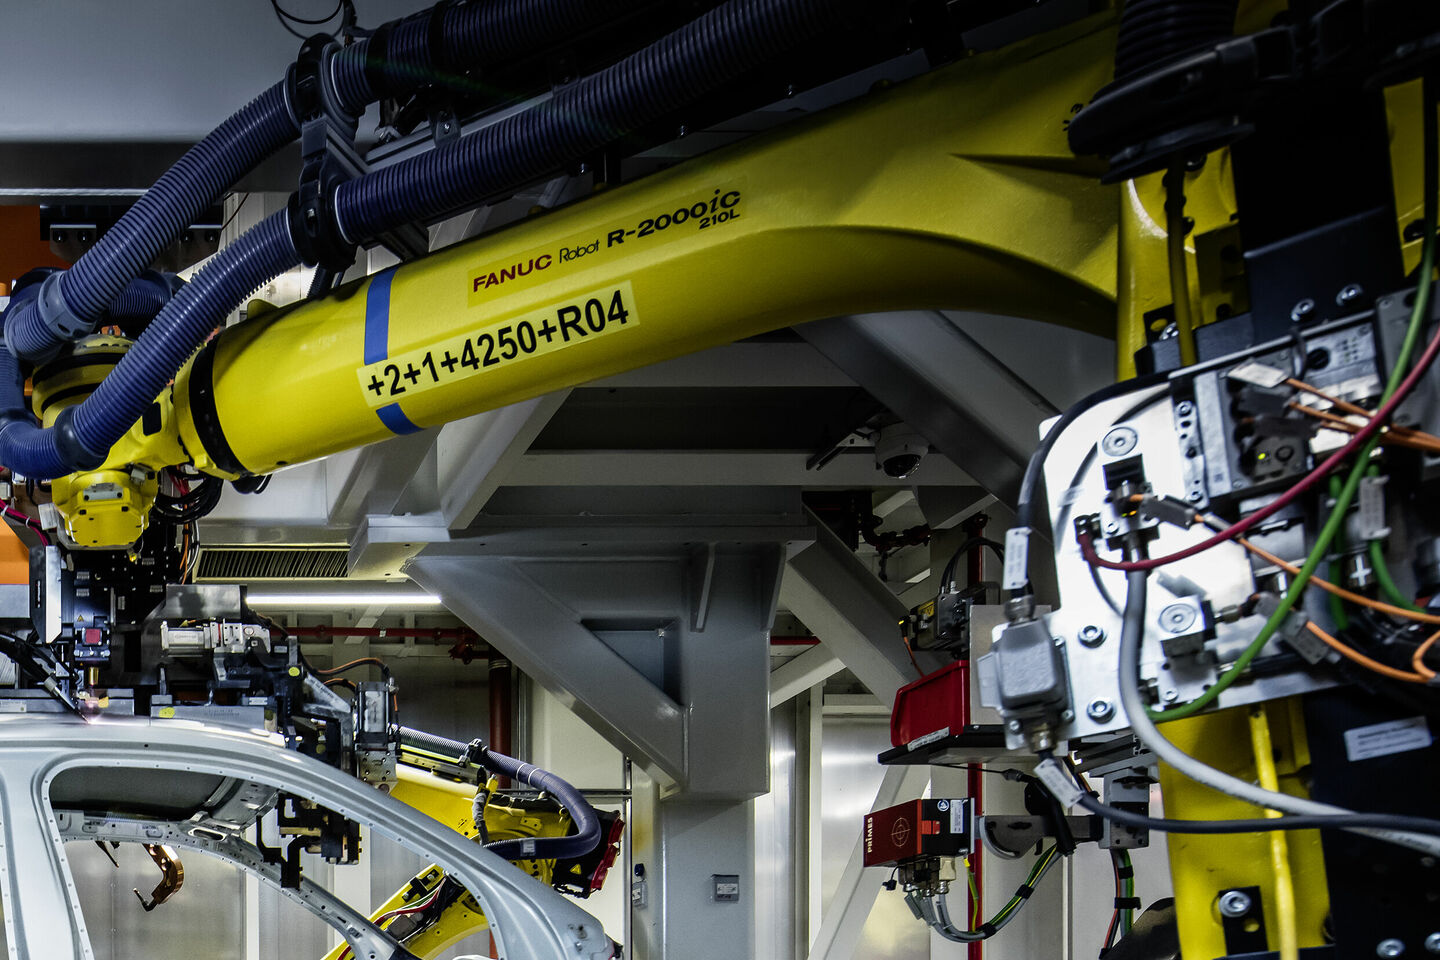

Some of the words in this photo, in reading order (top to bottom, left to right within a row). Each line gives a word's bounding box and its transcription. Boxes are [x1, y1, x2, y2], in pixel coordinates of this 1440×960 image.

[698, 210, 741, 230] 210L
[472, 253, 553, 293] FANUC
[559, 239, 600, 264] Robot
[366, 289, 630, 398] +2+1+4250+R04
